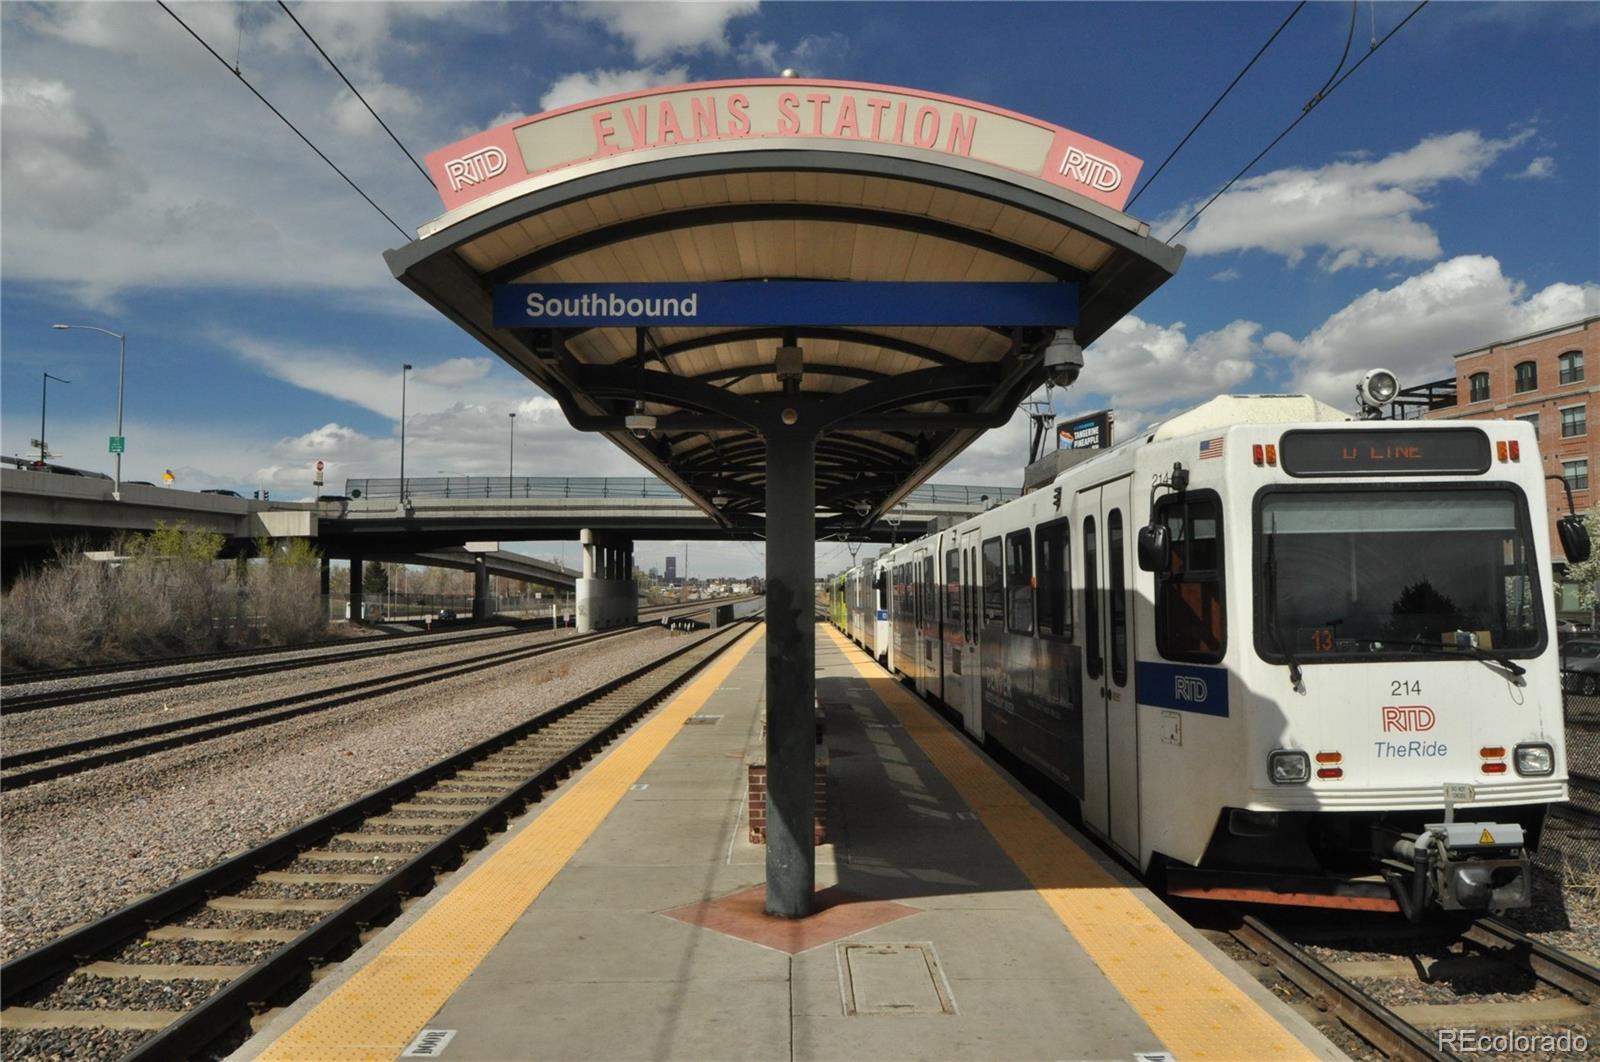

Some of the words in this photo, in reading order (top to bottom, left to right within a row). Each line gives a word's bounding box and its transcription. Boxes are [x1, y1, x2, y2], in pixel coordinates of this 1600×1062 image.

[592, 93, 751, 155] EVANS
[777, 92, 977, 157] STATION
[444, 145, 508, 192] RTD
[1059, 146, 1122, 193] RTD
[526, 292, 698, 317] Southbound
[1369, 447, 1422, 459] LINE
[1151, 472, 1171, 487] 214
[1312, 629, 1333, 655] 13
[1175, 675, 1208, 702] RTD
[1391, 680, 1422, 696] 214
[1382, 705, 1436, 733] RTD
[1374, 741, 1448, 758] TheRide
